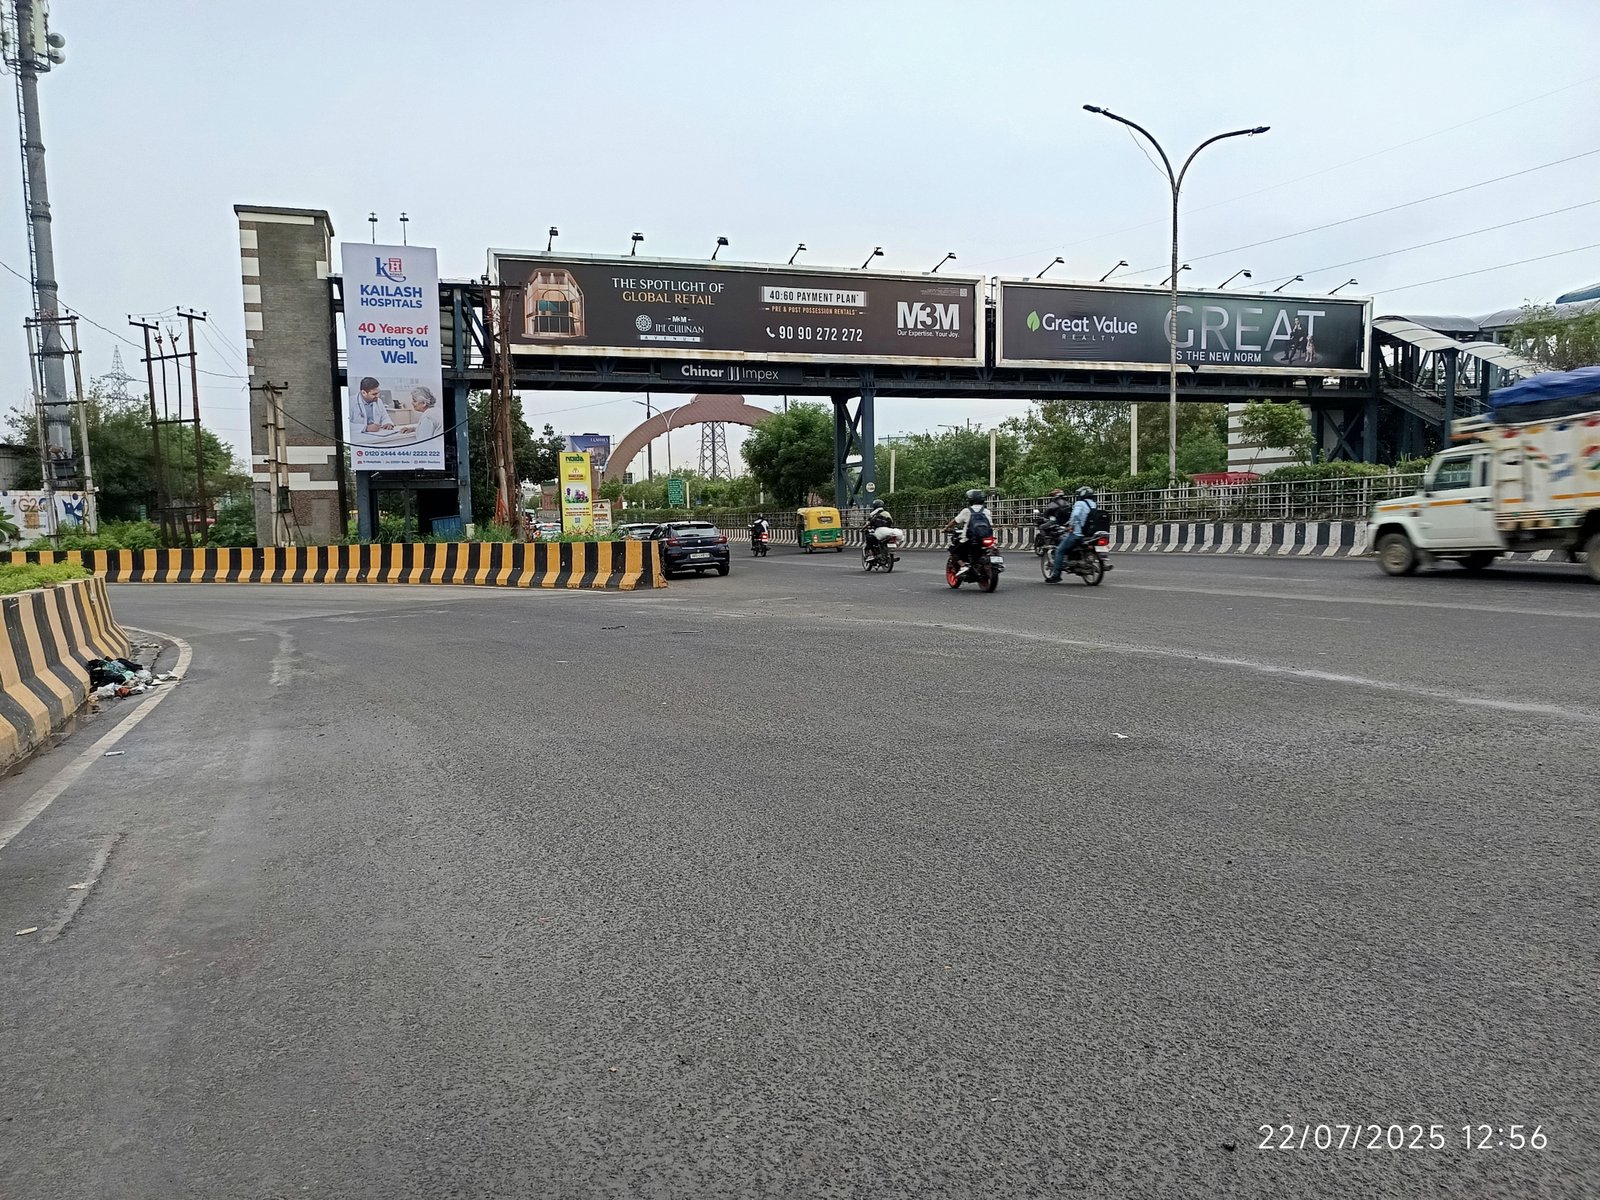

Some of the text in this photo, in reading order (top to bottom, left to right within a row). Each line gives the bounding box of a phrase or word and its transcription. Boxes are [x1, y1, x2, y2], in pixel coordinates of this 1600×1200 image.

[360, 284, 423, 298] KAILASH
[612, 277, 725, 293] THE SPOTLIGHT OF
[360, 297, 423, 309] HOSPITALS
[622, 291, 716, 306] GLOBAL RETAIL
[769, 290, 794, 301] 40:60
[796, 292, 833, 303] PAYMENT
[897, 301, 960, 331] M3M
[358, 323, 428, 335] 40 Years of
[667, 324, 704, 334] CULLINAN
[1042, 313, 1138, 334] Great Value
[1163, 305, 1326, 351] GREAT
[779, 325, 863, 342] 90 90 272 272
[1061, 333, 1116, 342] REALTY
[358, 335, 429, 349] Treating You
[381, 351, 418, 364] Well.
[1185, 350, 1206, 362] THE
[1208, 351, 1231, 363] NEW
[1234, 352, 1262, 364] NORM
[681, 364, 779, 382] Chinar Impex
